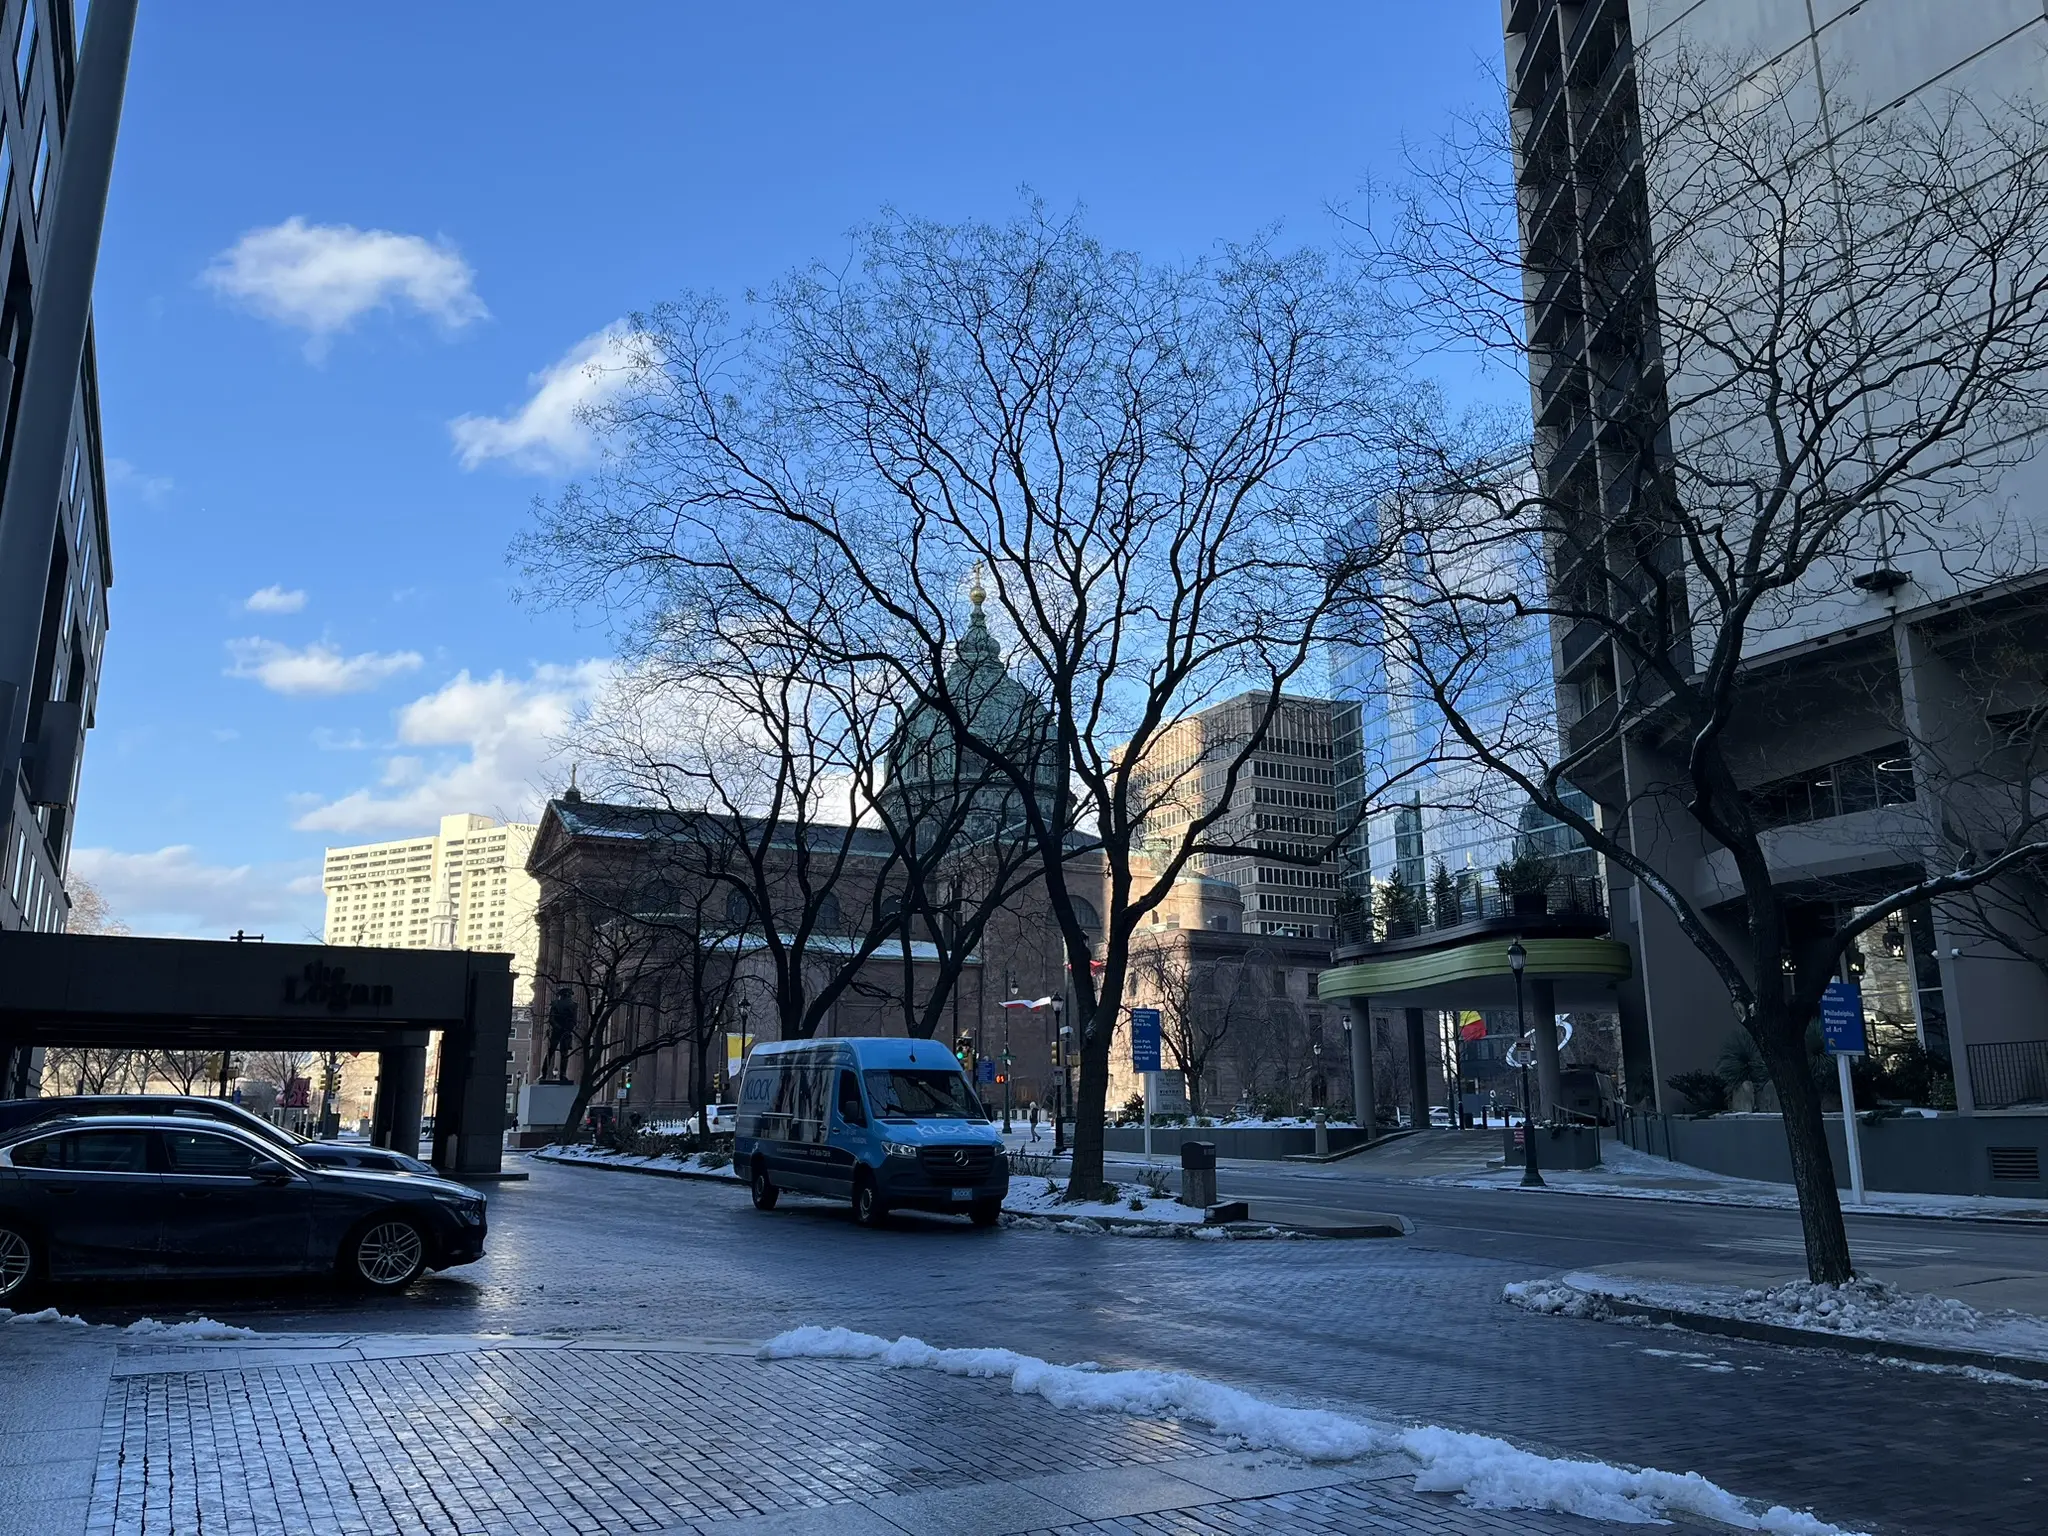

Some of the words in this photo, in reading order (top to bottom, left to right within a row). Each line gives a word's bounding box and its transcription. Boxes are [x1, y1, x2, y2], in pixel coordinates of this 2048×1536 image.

[304, 958, 346, 983] the
[283, 976, 393, 1012] Logan
[1824, 1009, 1854, 1017] Philadelphia
[744, 1078, 773, 1101] KLOCK
